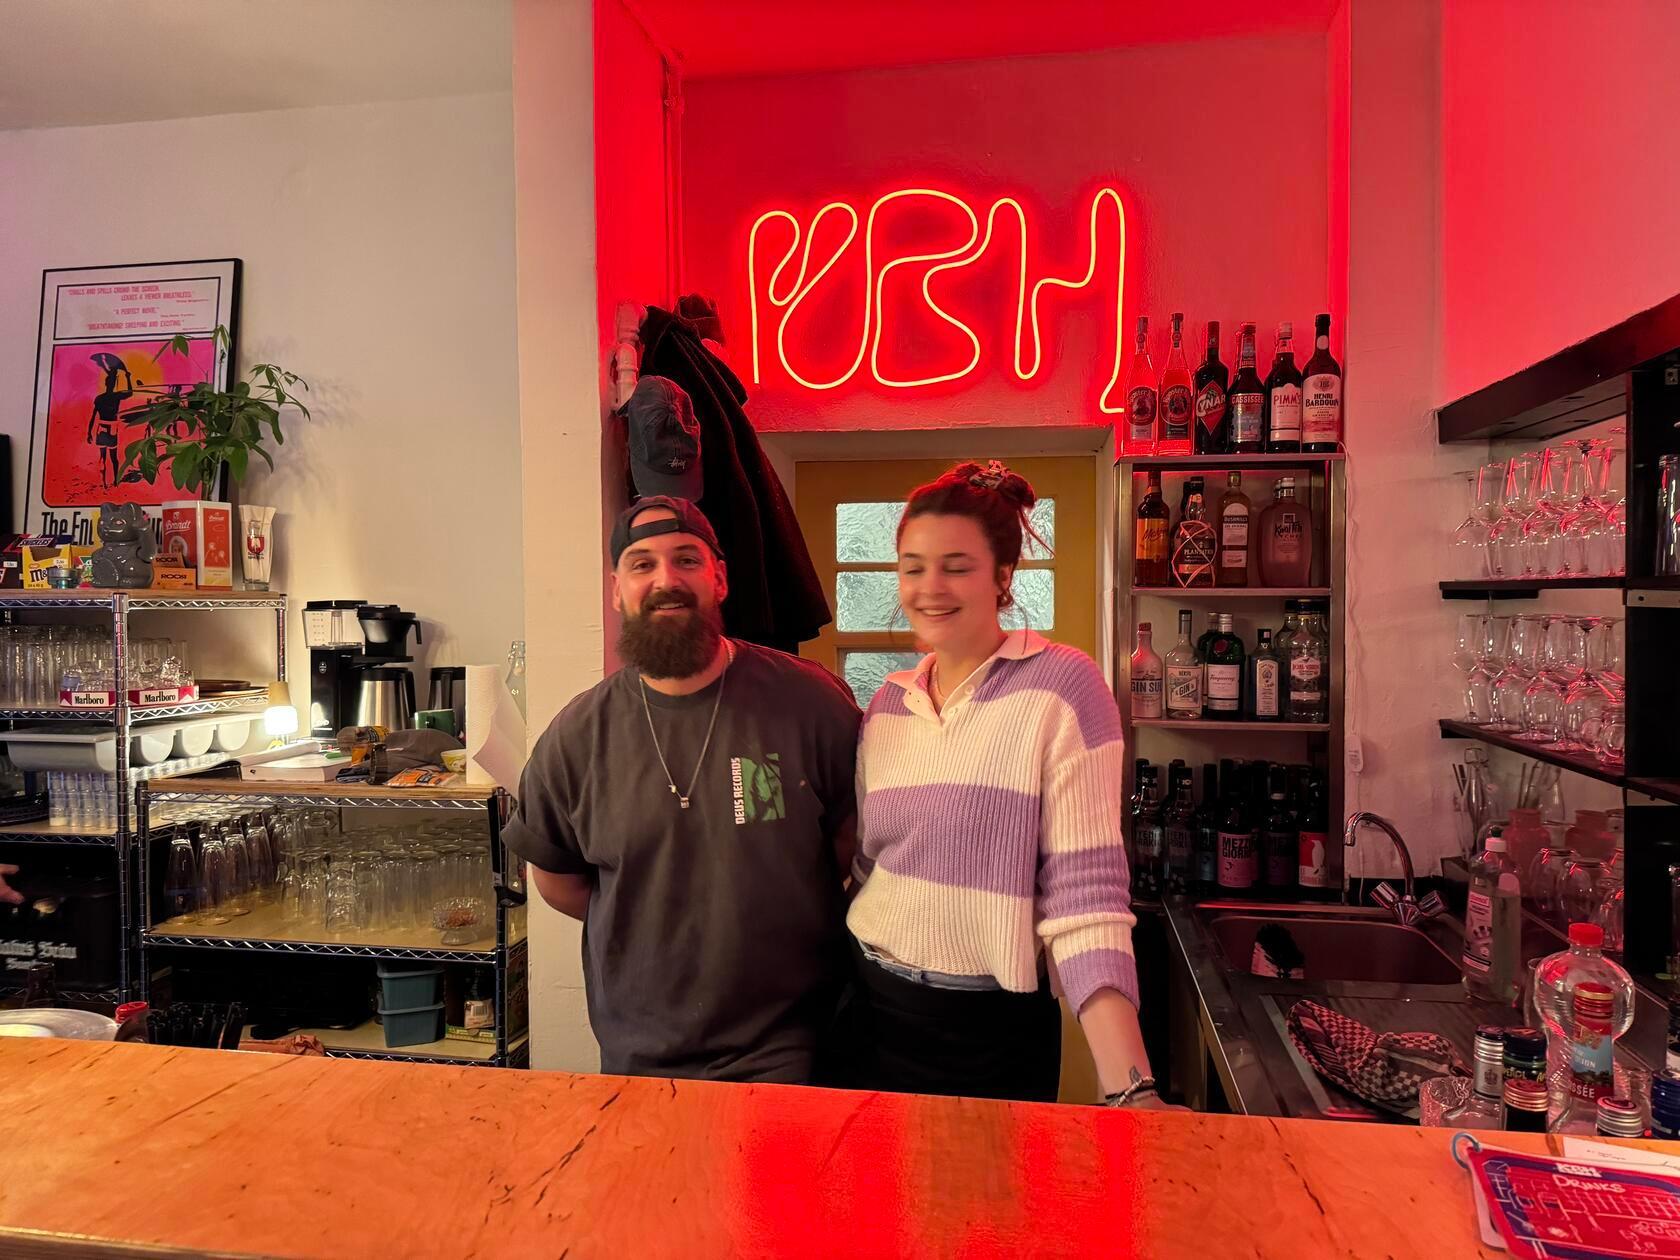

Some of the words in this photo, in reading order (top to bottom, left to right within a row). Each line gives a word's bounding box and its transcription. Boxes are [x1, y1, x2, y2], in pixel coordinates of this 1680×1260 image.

[1195, 394, 1226, 417] CYNAR
[41, 511, 68, 536] The
[165, 520, 191, 531] Brandt
[1131, 681, 1147, 693] GIN
[1179, 683, 1190, 695] GIN
[74, 694, 104, 705] Marlboro
[144, 691, 176, 703] Marlboro
[731, 757, 744, 799] RECORDS
[1552, 1174, 1626, 1194] DRINKS
